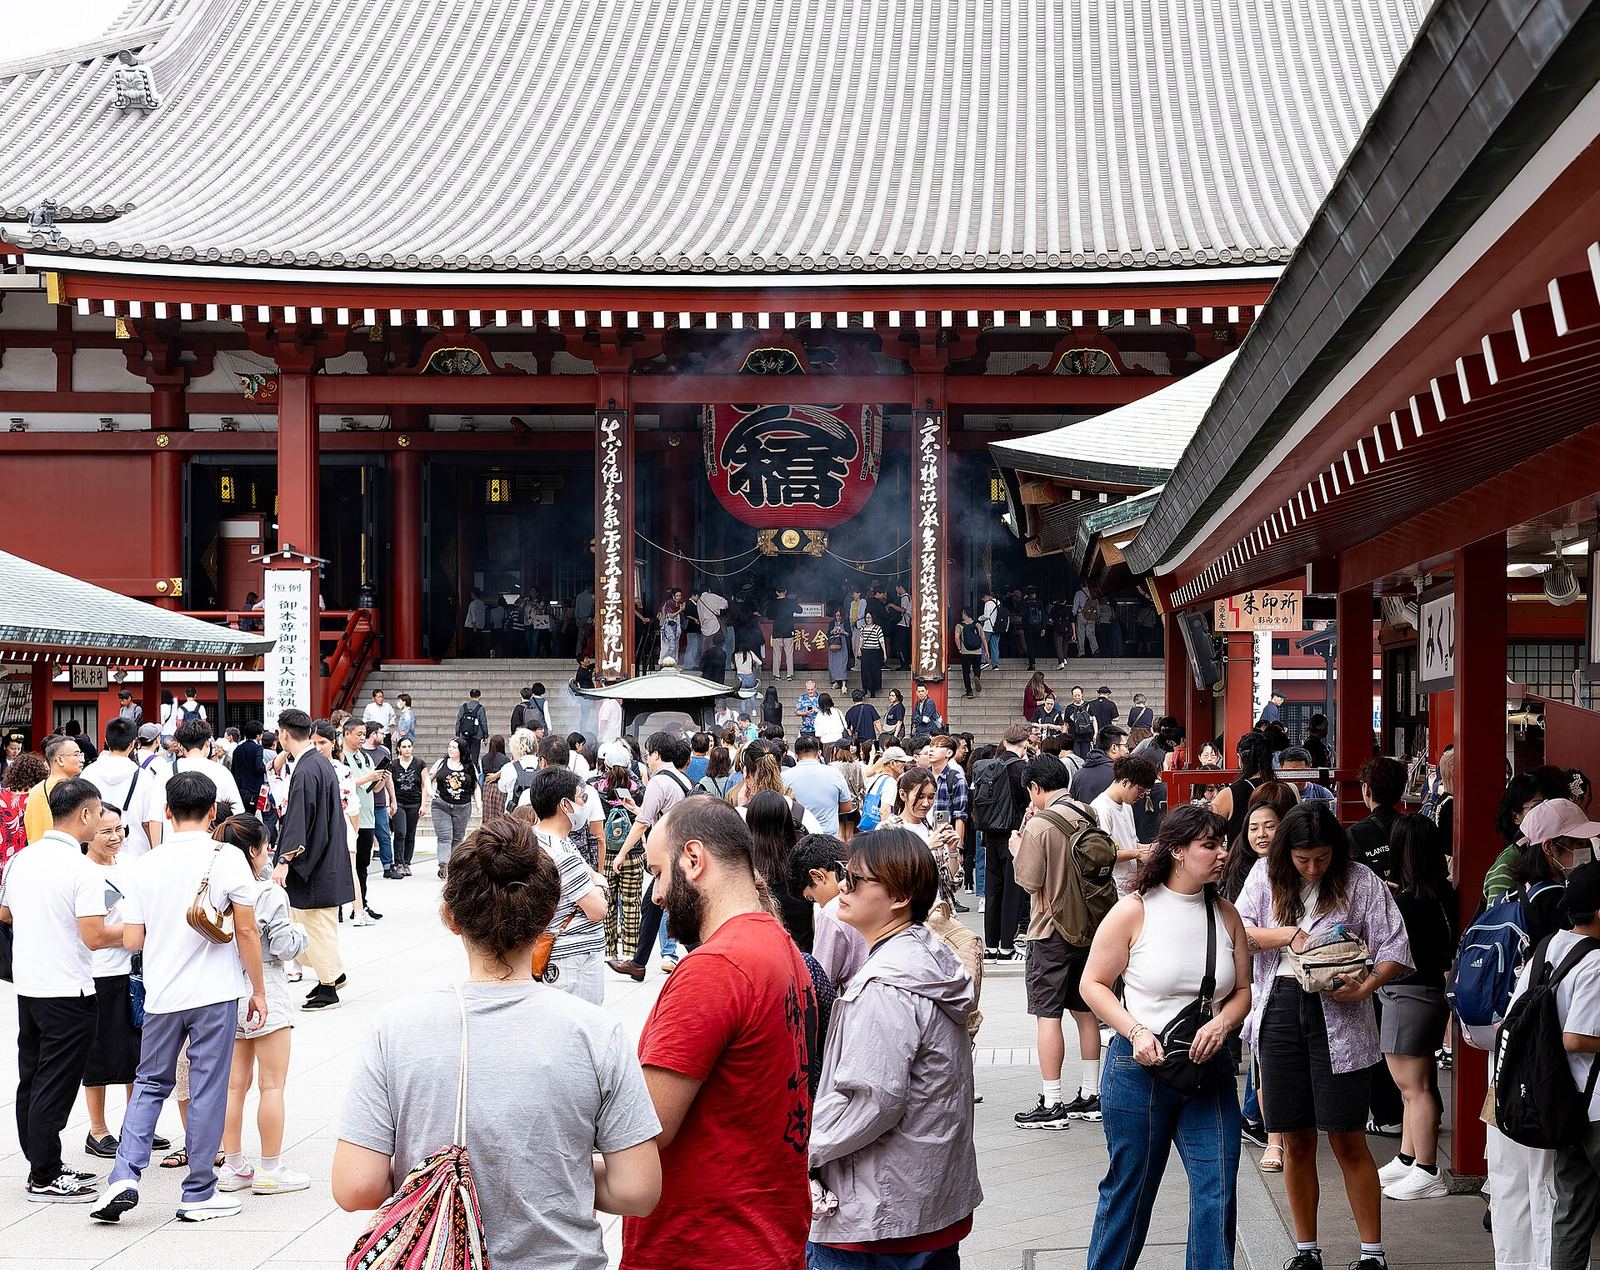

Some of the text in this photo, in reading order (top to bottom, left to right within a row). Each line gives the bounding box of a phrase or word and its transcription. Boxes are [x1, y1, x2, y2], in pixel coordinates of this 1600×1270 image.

[272, 583, 301, 592] 恒例
[1243, 592, 1299, 616] 朱印所
[1365, 845, 1390, 857] PLANTS
